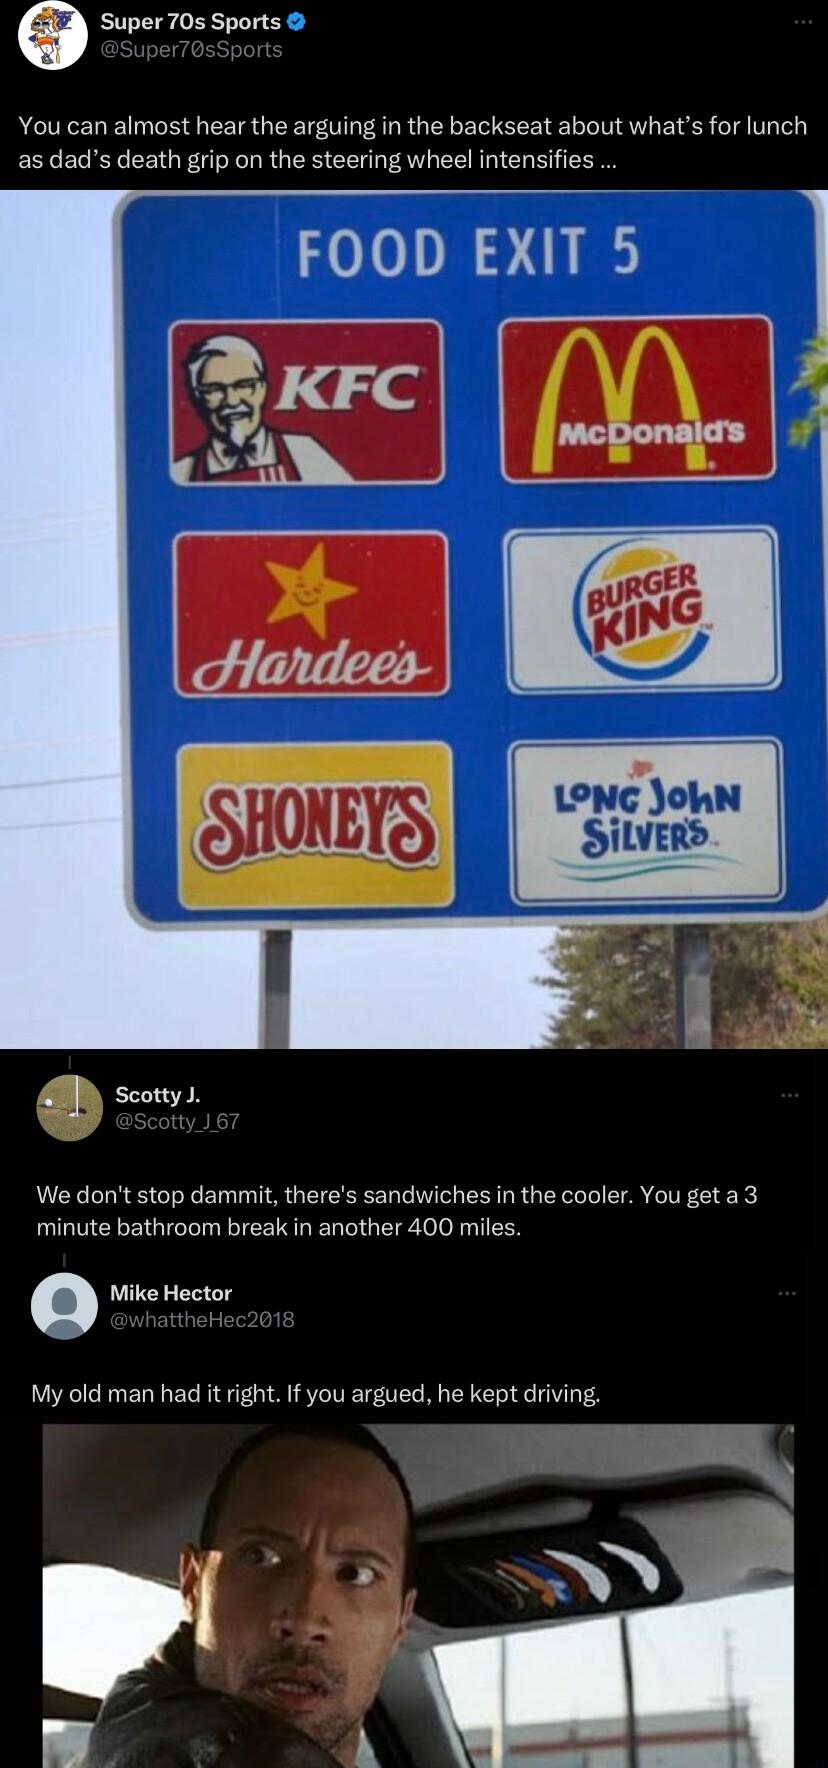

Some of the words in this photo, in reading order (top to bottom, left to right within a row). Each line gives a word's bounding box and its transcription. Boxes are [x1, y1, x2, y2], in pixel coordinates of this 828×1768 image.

[299, 227, 446, 277] FOOD
[475, 226, 586, 276] EXIT
[613, 225, 640, 274] 5
[273, 364, 422, 411] KFC
[557, 419, 746, 447] McDonald's
[587, 562, 698, 618] BURGER
[593, 588, 703, 654] KING
[192, 638, 433, 692] Hardee's
[199, 785, 438, 867] SHONEY'S
